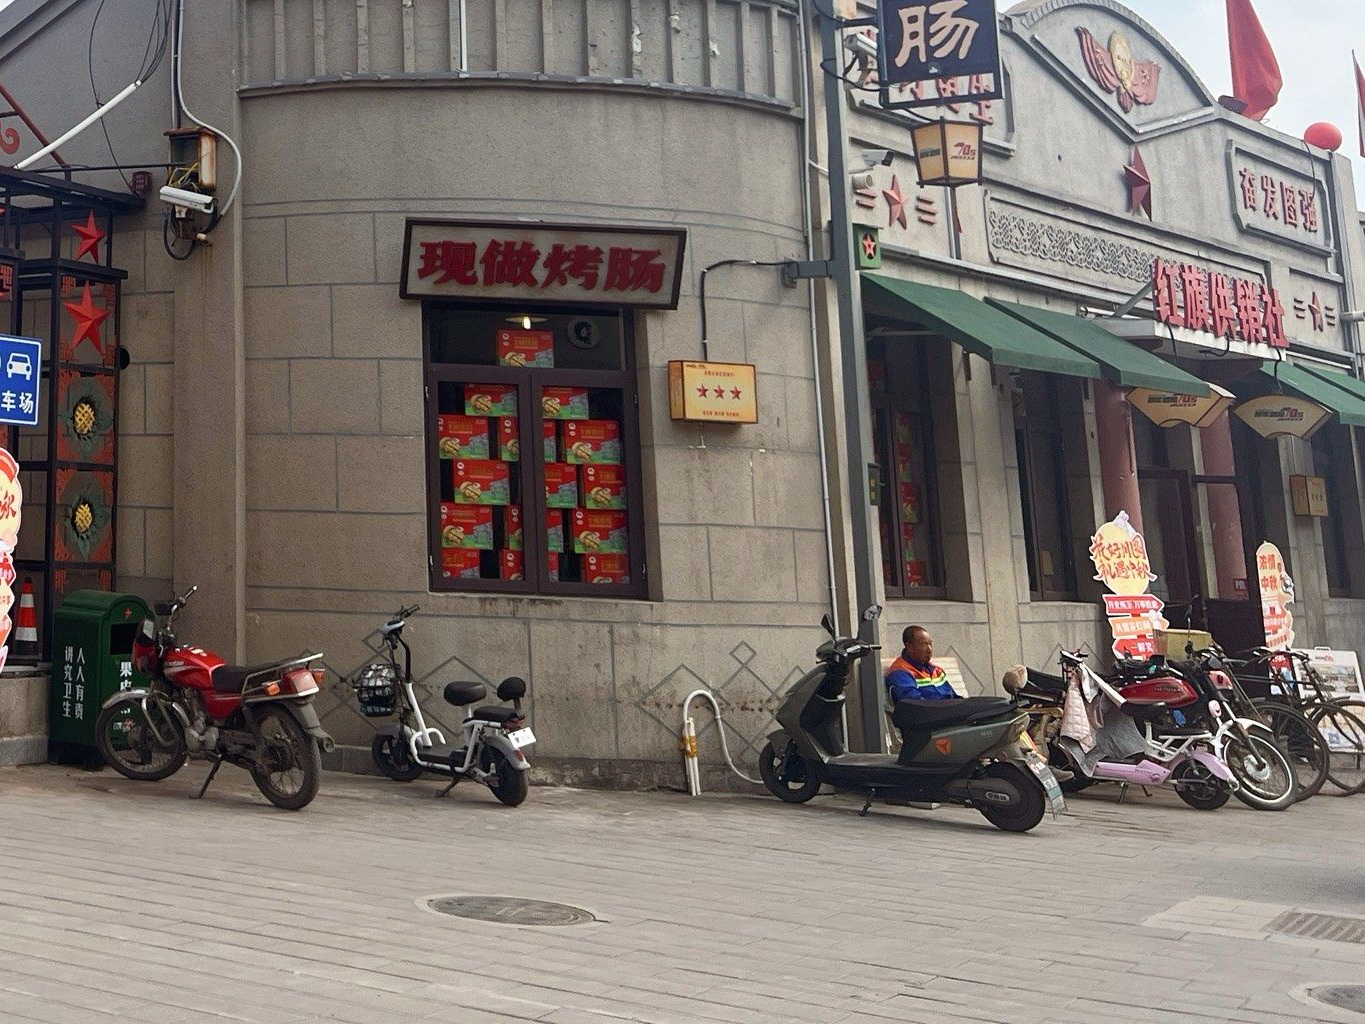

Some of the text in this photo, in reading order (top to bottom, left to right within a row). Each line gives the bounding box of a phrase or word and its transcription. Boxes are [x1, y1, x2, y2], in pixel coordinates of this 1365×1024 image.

[1238, 167, 1318, 234] 奋发图强
[417, 238, 666, 294] 现做烤肠
[1151, 256, 1290, 349] 红旗供销社
[62, 645, 74, 718] 讲究卫生
[74, 647, 85, 720] 人人有责
